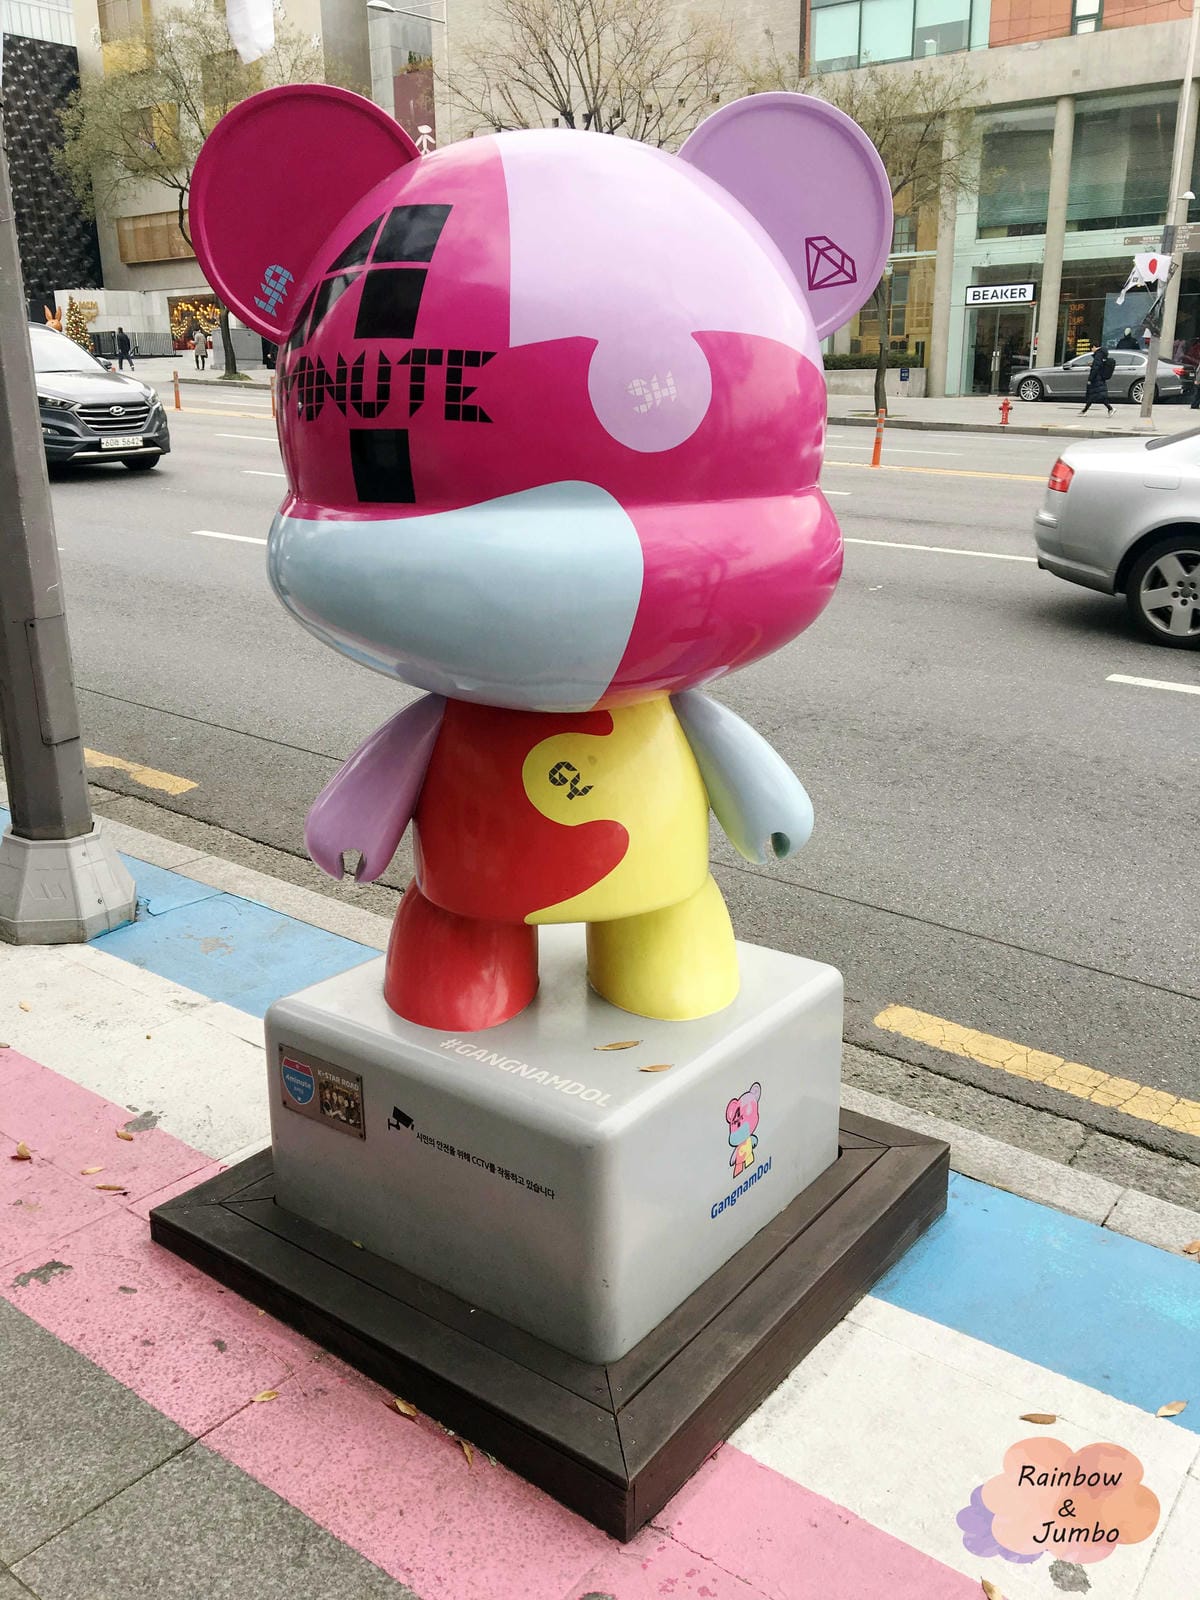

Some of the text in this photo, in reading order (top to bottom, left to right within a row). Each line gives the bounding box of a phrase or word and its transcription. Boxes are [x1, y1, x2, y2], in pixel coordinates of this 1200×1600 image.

[972, 287, 1027, 301] BEAKER
[341, 1078, 359, 1092] ROAD
[439, 1038, 612, 1107] #GANGNAMDOL
[416, 1132, 555, 1200] 시민의 안전을 위해 CCTV를 작동하고 있습니다
[711, 1156, 772, 1219] GangnamDol
